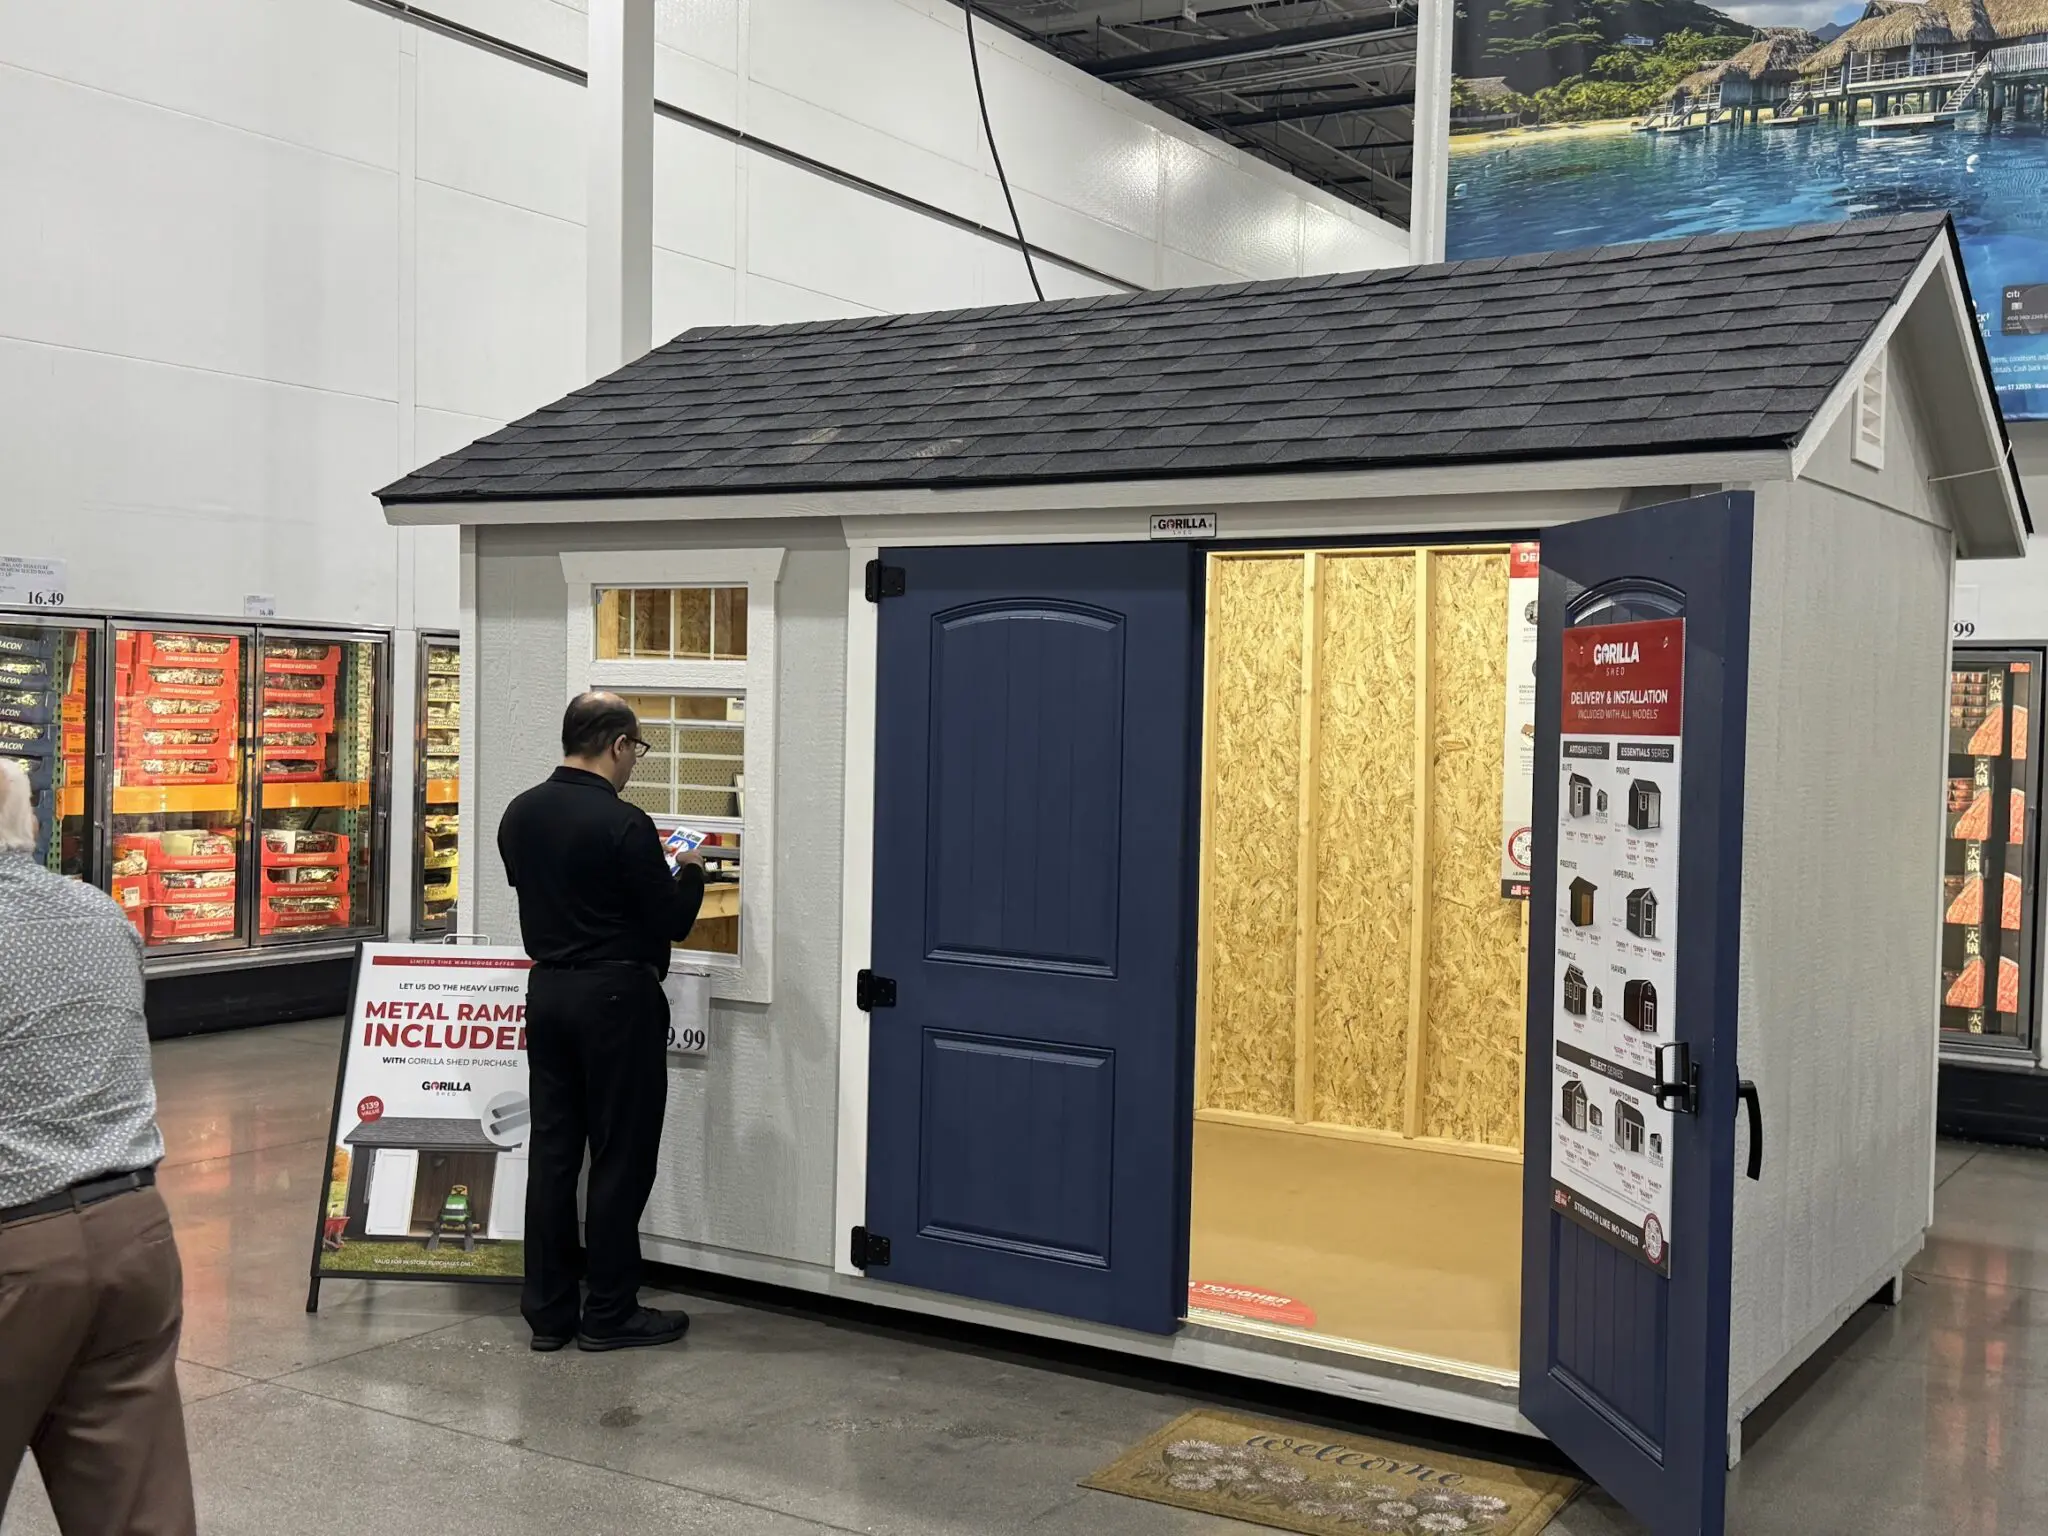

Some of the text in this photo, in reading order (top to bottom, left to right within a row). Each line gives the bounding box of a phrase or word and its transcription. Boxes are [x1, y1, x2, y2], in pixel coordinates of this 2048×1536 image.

[2006, 290, 2020, 299] citi
[1158, 518, 1207, 530] GORILLA
[28, 591, 64, 606] 16.49
[1954, 622, 1975, 638] 99
[1593, 641, 1640, 666] GORILLA
[1606, 666, 1625, 677] SHED
[1570, 689, 1668, 705] DELIVERY & INSTALLATION
[0, 708, 21, 717] ACON
[1577, 709, 1605, 719] INCLUDED
[1605, 709, 1620, 719] WITH
[1620, 709, 1631, 719] ALL
[1569, 744, 1588, 754] ARTISAN
[1620, 747, 1670, 758] ESSENTIALS SERIES
[1613, 869, 1635, 880] IMPERIAL
[1610, 963, 1627, 975] HAVEN
[442, 984, 458, 992] THE
[459, 985, 488, 993] HEAVY
[488, 985, 520, 993] LIFTING
[365, 1001, 449, 1021] METAL
[667, 1026, 706, 1051] 9.99
[382, 1056, 519, 1067] WITH GORILLA SHED PURCHASE
[422, 1081, 471, 1092] GORILLA
[1608, 1086, 1632, 1103] HAMPTON
[360, 1100, 380, 1111] $139
[361, 1108, 380, 1117] VALUE
[1574, 1201, 1639, 1247] STRENGTH LIKE NO OTHER
[1202, 1283, 1292, 1305] TOUGHER
[1246, 1435, 1465, 1487] welcome
